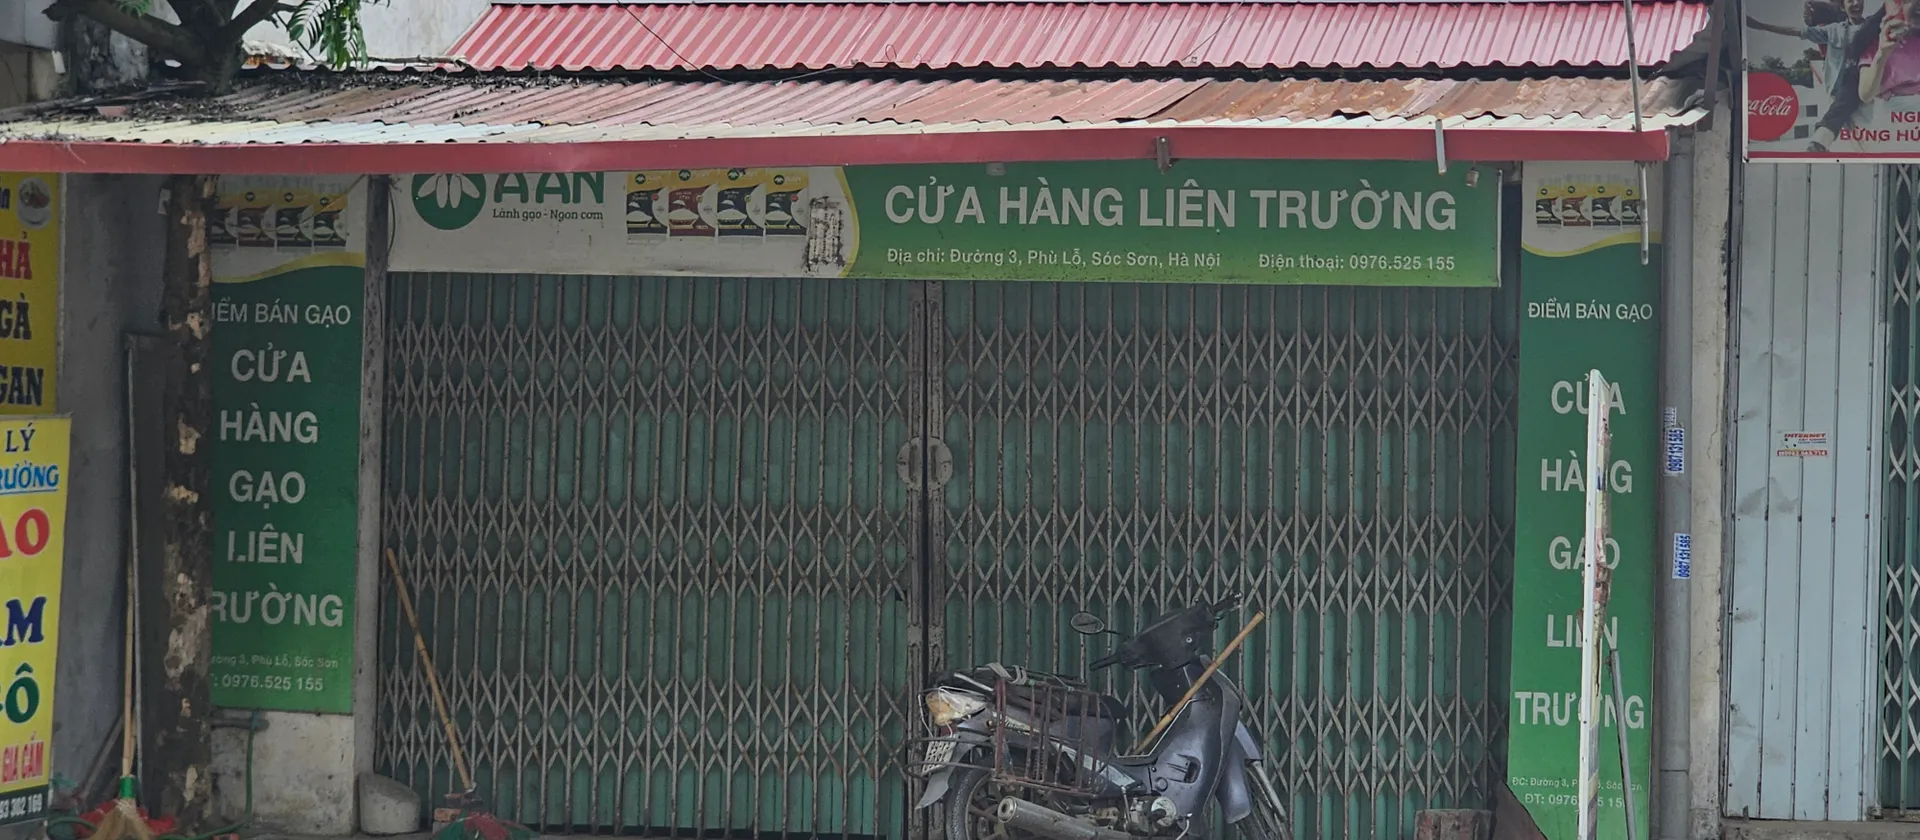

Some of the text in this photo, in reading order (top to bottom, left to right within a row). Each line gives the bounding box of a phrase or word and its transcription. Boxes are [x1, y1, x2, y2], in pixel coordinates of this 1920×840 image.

[1840, 126, 1890, 142] BỪNG
[1891, 111, 1920, 124] NG
[550, 209, 578, 222] Ngon
[885, 176, 1456, 231] CỬA HÀNG LIÊN TRƯỜNG
[887, 248, 912, 265] Địa
[950, 249, 1004, 266] Đường
[1009, 250, 1023, 266] 3,
[1092, 251, 1122, 266] Sóc
[1127, 251, 1163, 268] Sơn,
[1169, 252, 1189, 266] Hà
[1194, 252, 1220, 268] Nội
[1259, 253, 1455, 272] Điện thoại: 0976.525 155
[211, 296, 351, 329] IỂM BÁN GẠO
[1527, 297, 1653, 323] ĐIỂM BÁN GẠO
[231, 342, 312, 384] CỬA
[6, 422, 36, 452] LÝ
[219, 402, 319, 444] HÀNG
[1541, 450, 1633, 494] HÀG
[229, 469, 306, 509] GẠO
[227, 523, 305, 564] LIÊN
[210, 582, 344, 628] RƯỜNG
[1514, 690, 1645, 729] TRƯNG
[1524, 793, 1626, 809] ĐT: 09765 15
